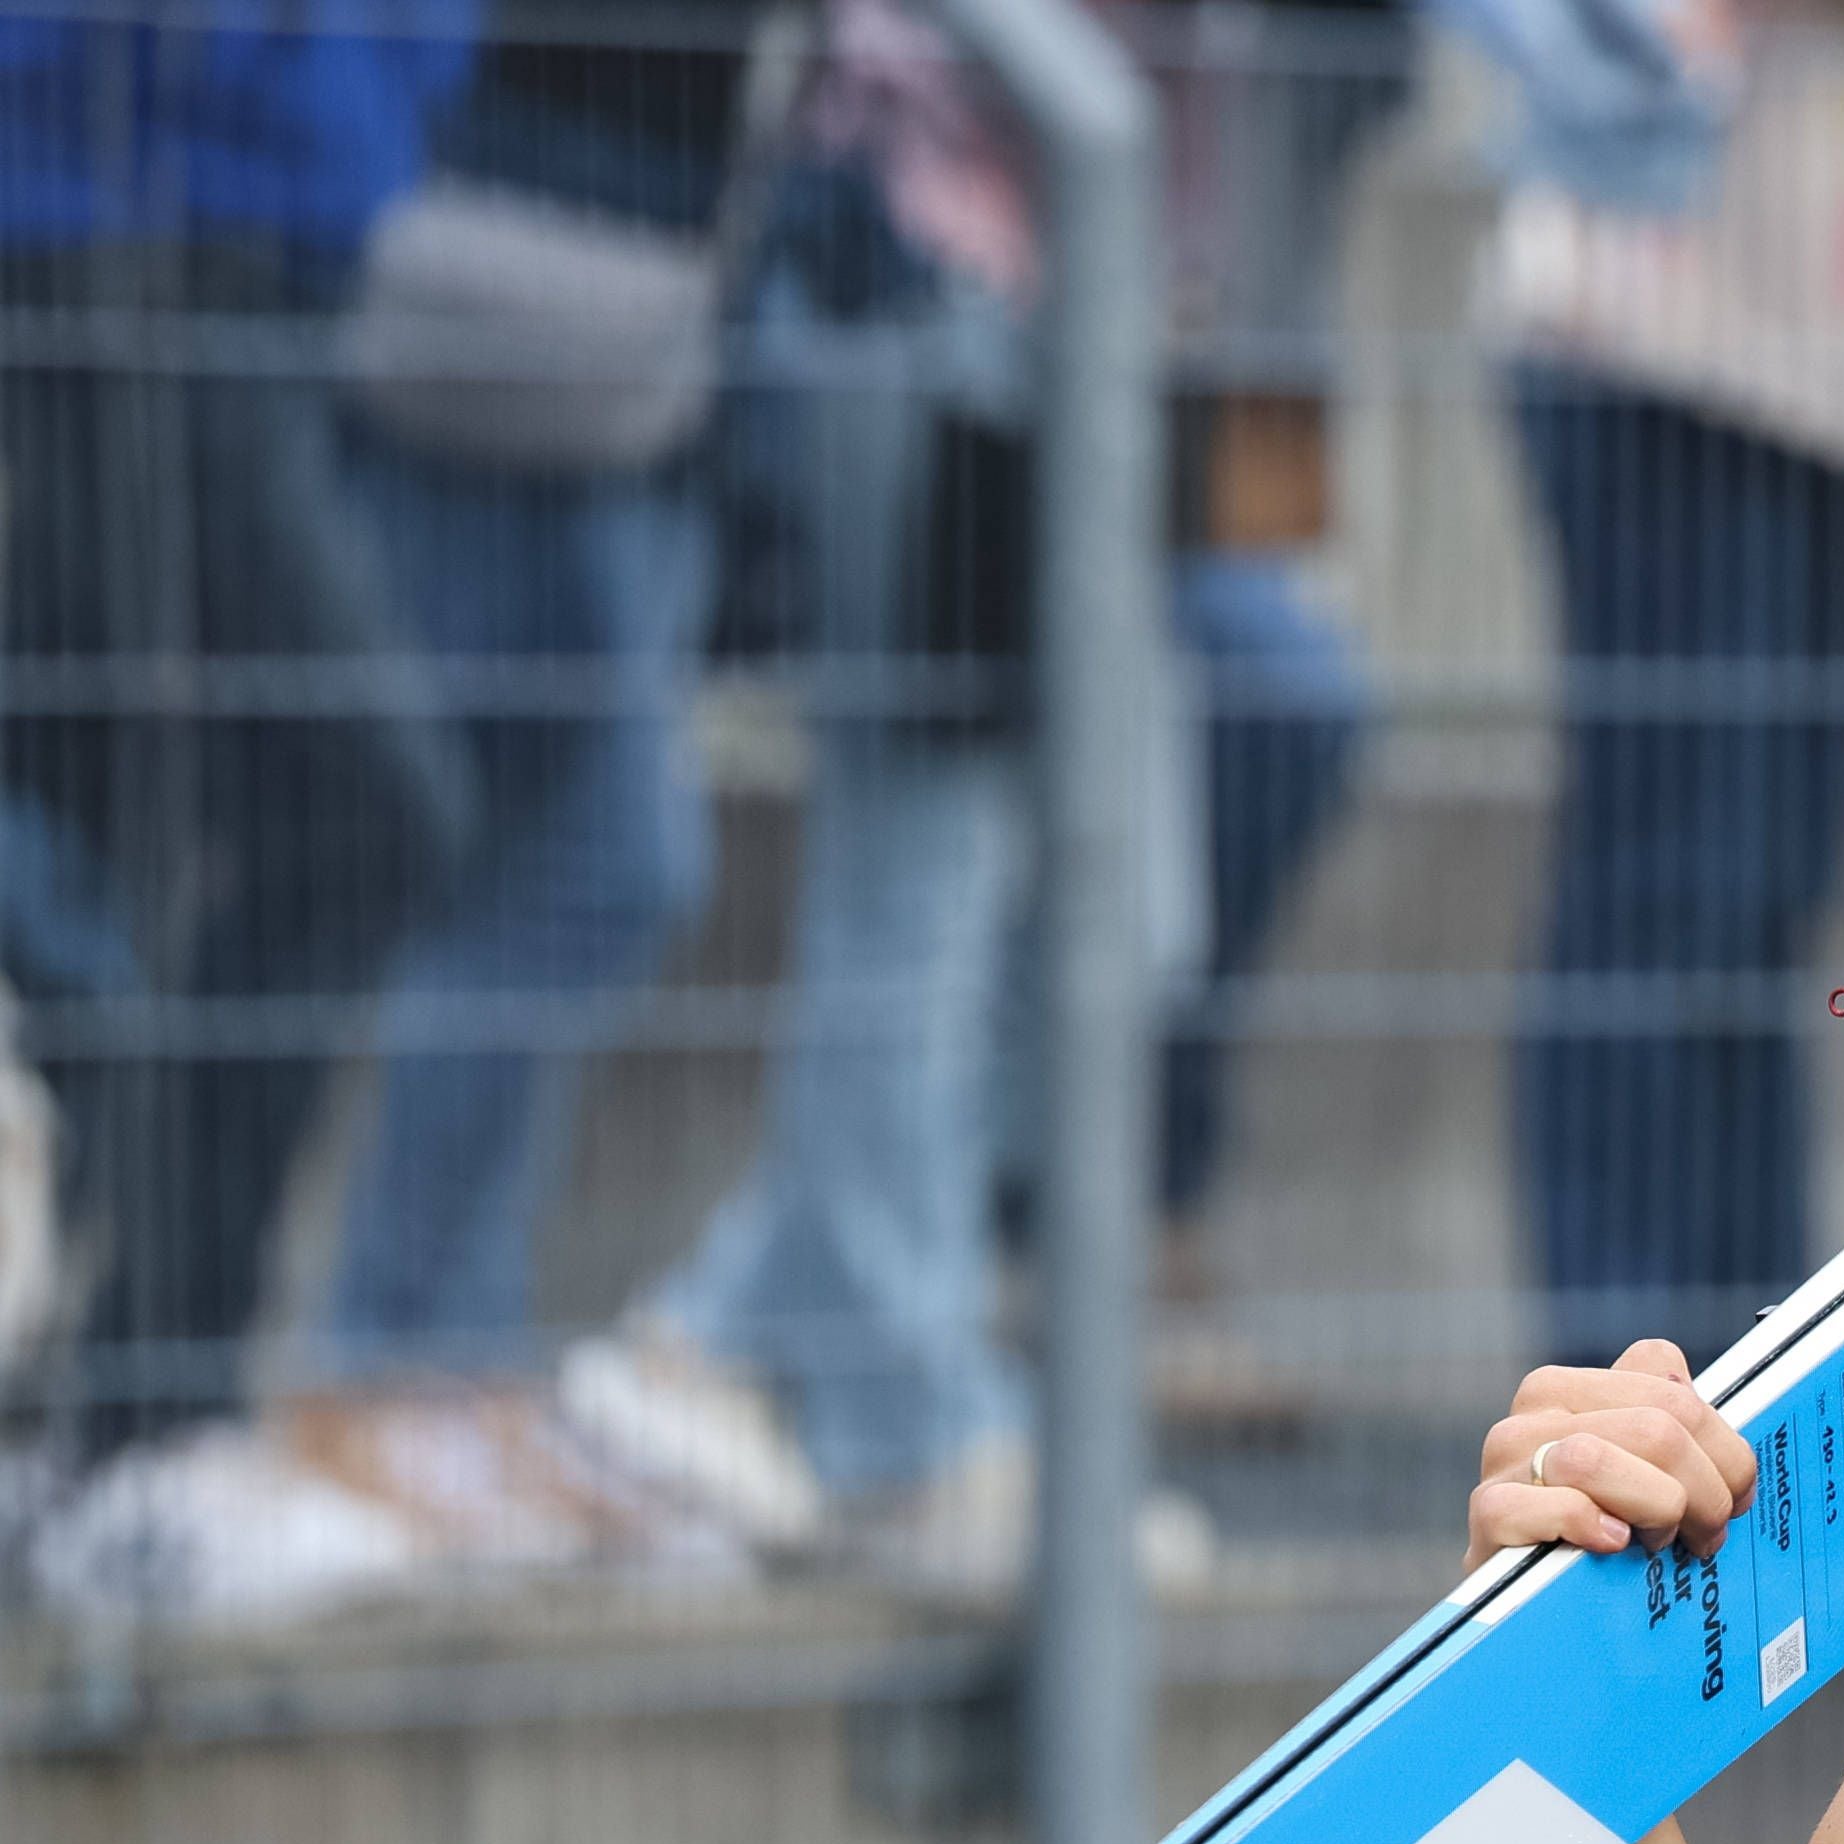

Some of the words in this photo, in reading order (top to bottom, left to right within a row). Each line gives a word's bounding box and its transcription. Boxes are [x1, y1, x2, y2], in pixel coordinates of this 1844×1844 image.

[1774, 1421, 1791, 1499] World
[1777, 1498, 1791, 1552] Cup
[1646, 1551, 1671, 1632] est
